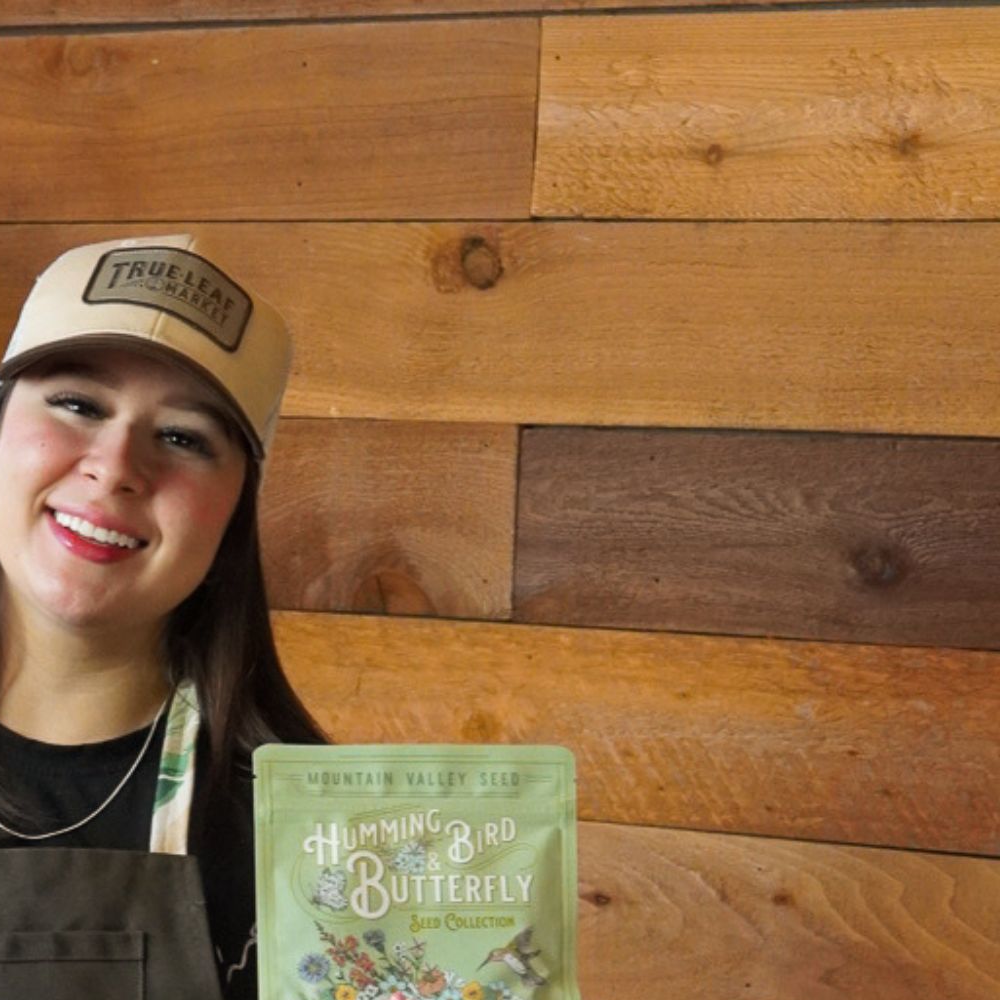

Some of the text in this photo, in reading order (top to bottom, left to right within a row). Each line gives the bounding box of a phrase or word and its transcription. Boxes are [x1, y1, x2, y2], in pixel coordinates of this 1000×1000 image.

[107, 260, 237, 312] TRUE LEAF
[164, 282, 228, 327] MARKET
[307, 771, 520, 787] MOUNTAIN VALLEY SEED
[303, 808, 516, 866] HUMMING BIRD
[426, 851, 441, 872] &
[346, 850, 534, 920] BUTTERFLY
[409, 912, 516, 933] SEED COLLECTION
